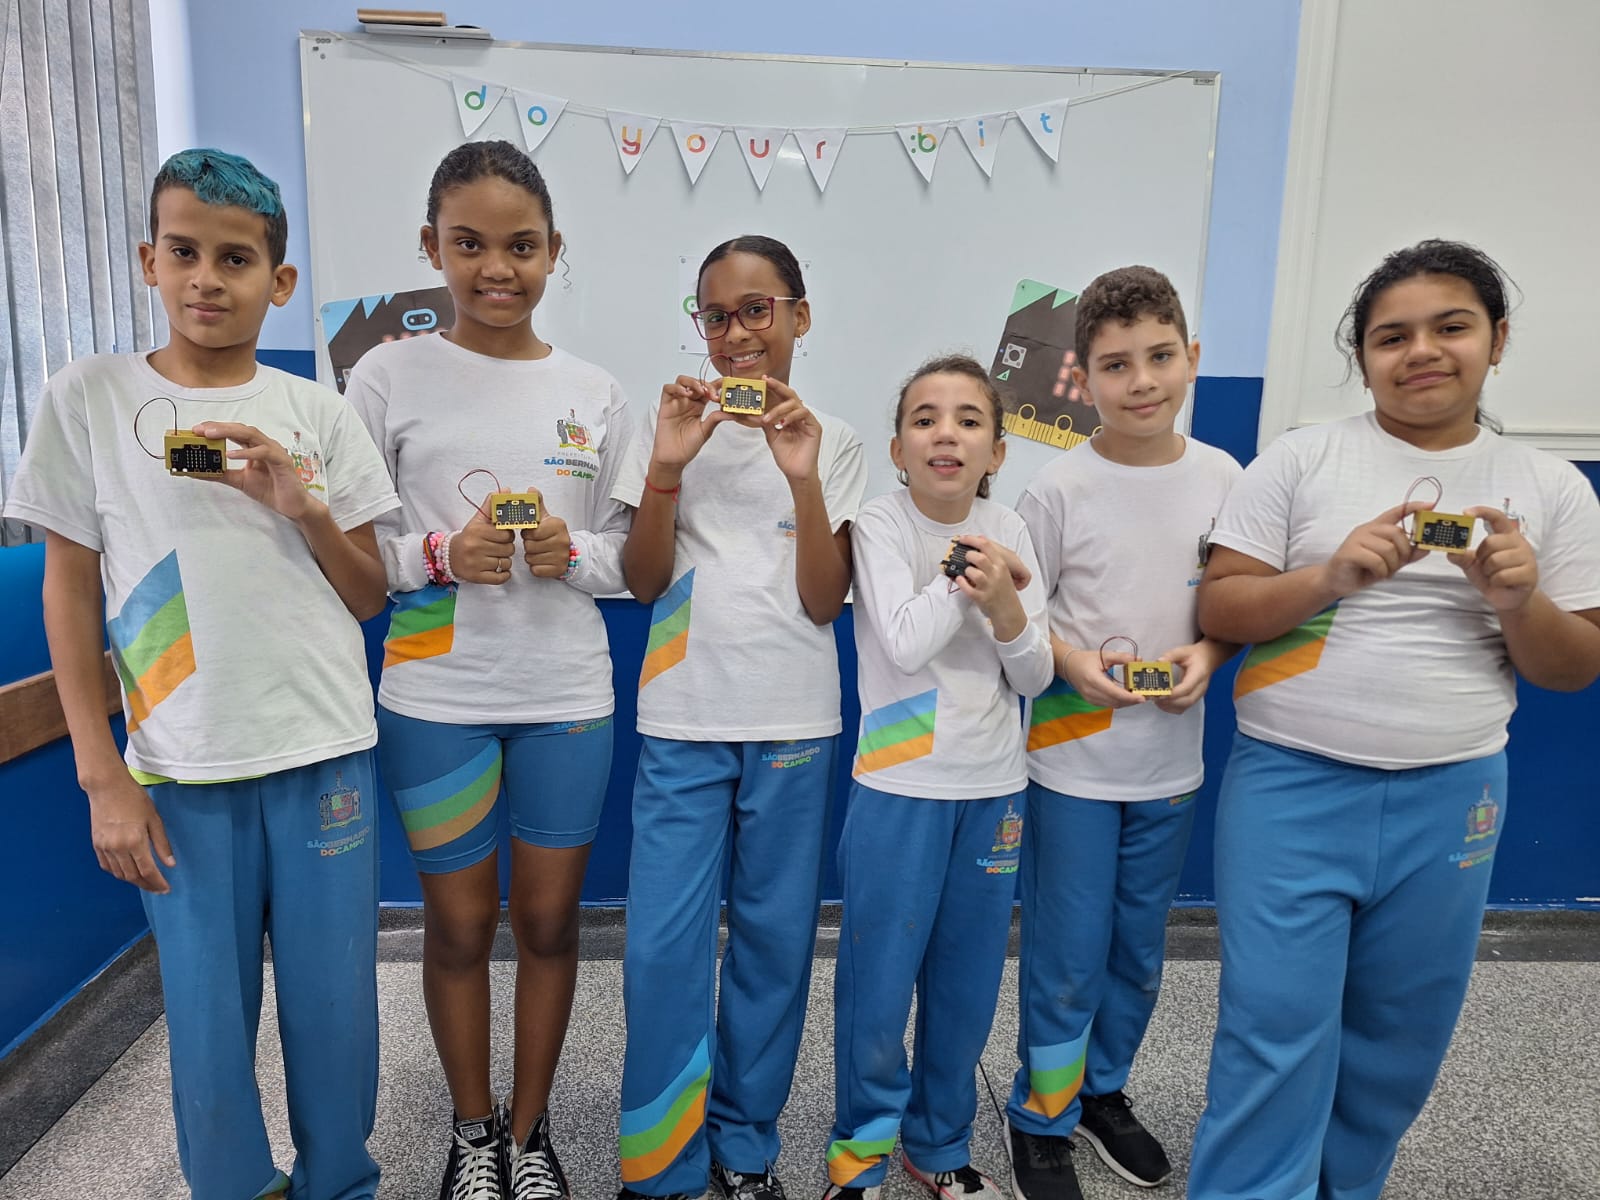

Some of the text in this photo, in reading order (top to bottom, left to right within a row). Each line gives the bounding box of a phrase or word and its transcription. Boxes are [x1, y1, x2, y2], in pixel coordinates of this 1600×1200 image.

[544, 457, 565, 465] SÃO
[307, 839, 327, 849] SÃO
[336, 838, 365, 855] CAMPO
